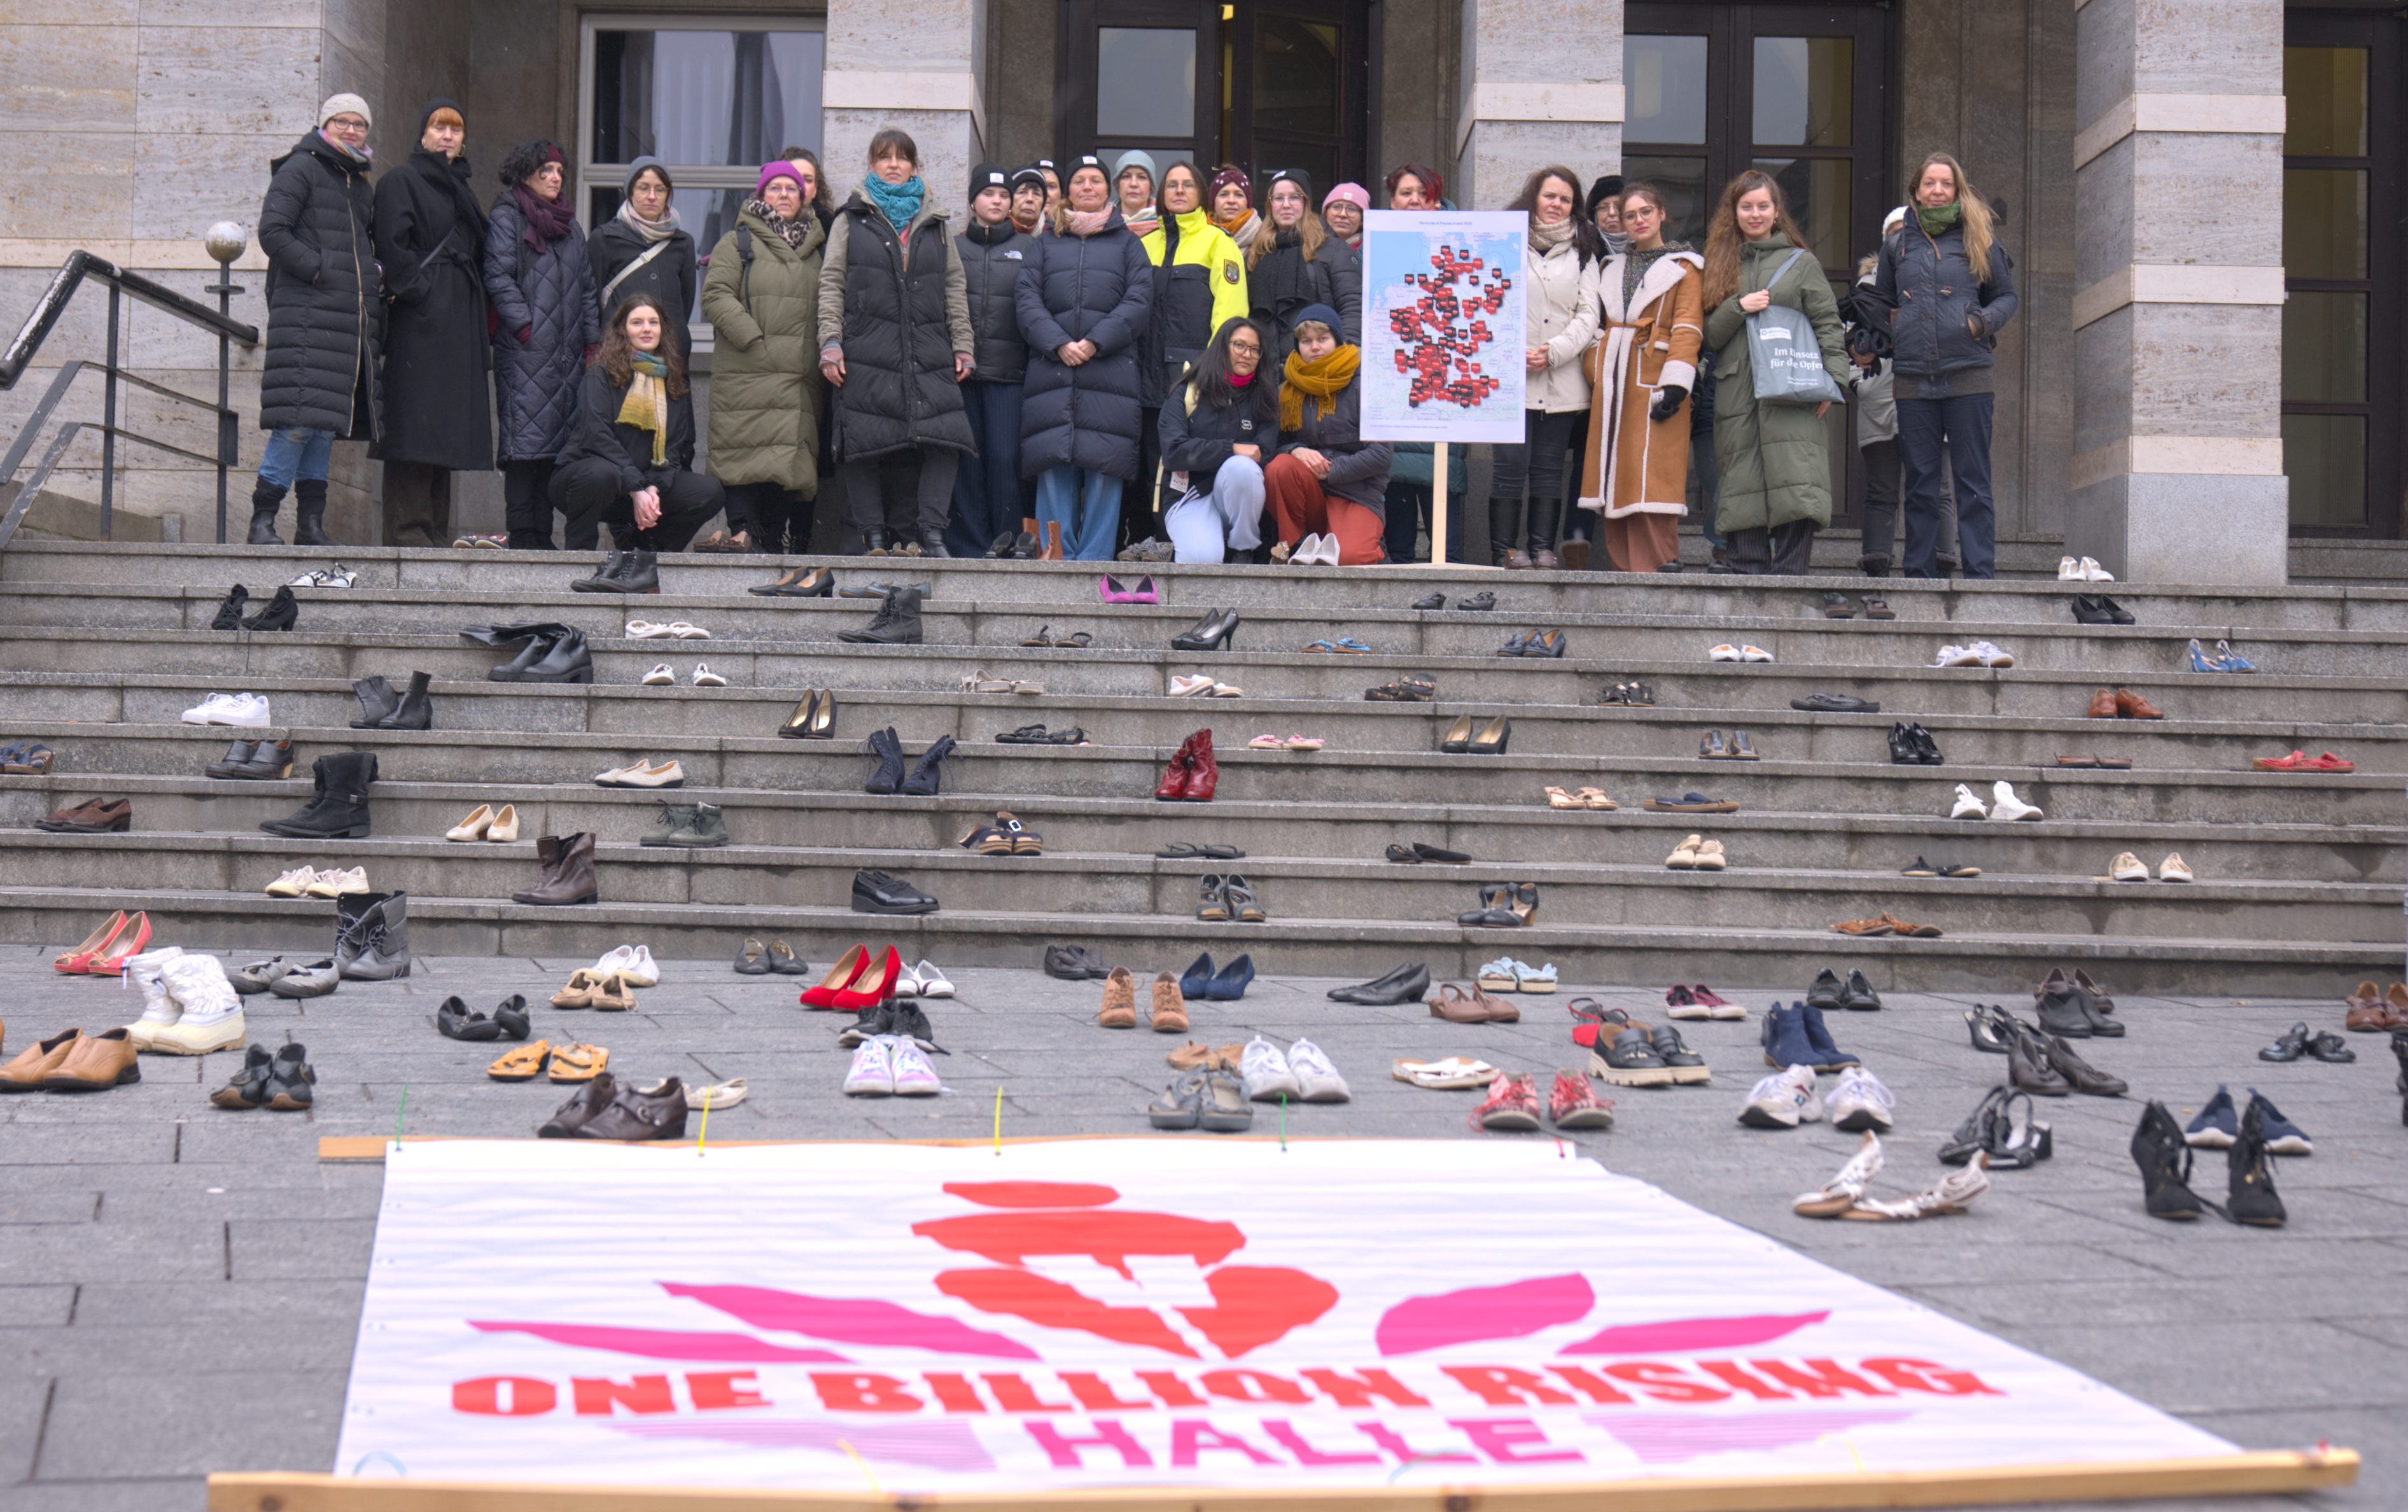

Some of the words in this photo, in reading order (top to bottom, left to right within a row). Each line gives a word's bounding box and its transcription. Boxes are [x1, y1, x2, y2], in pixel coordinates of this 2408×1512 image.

[1770, 358, 1785, 368] für
[1786, 358, 1798, 368] die
[1800, 360, 1823, 370] Opfer
[1774, 347, 1788, 356] Im
[1789, 347, 1819, 359] Einsatz
[452, 1369, 774, 1418] ONE
[806, 1368, 1435, 1414] BILLION
[1438, 1356, 2011, 1407] RISING
[1021, 1417, 1589, 1469] HALLE
